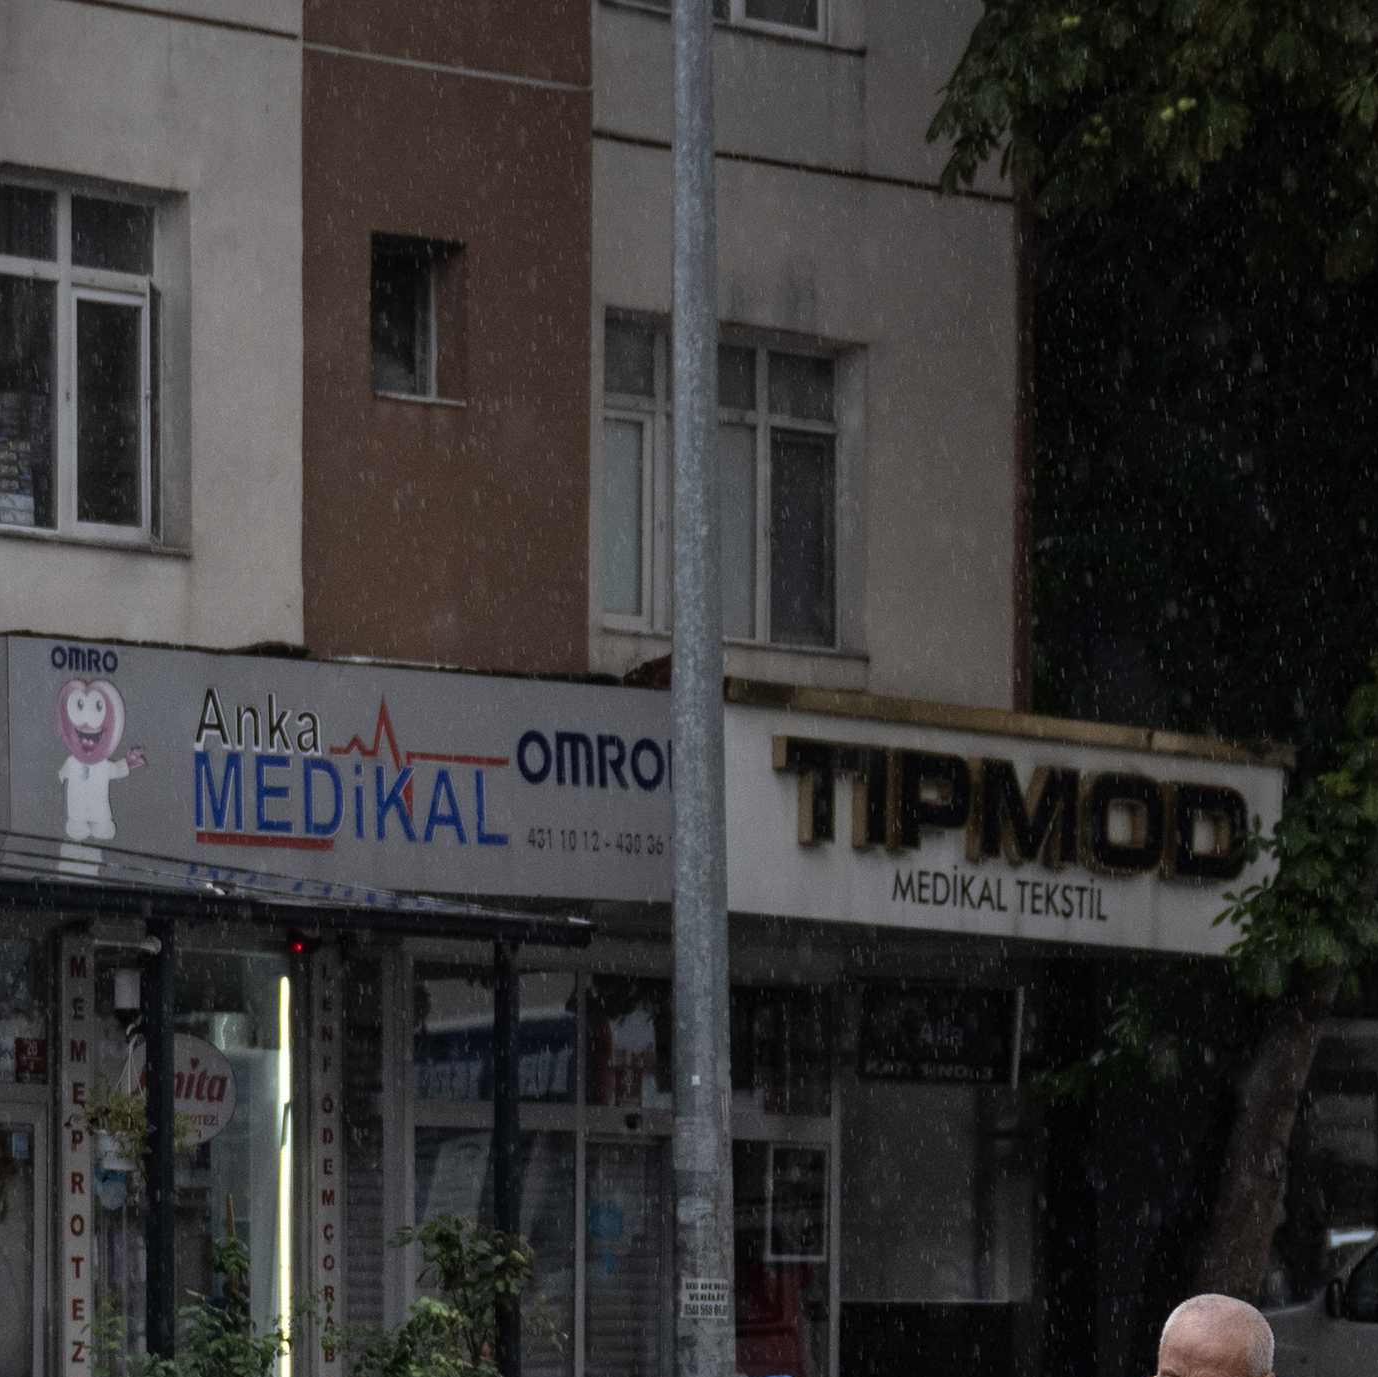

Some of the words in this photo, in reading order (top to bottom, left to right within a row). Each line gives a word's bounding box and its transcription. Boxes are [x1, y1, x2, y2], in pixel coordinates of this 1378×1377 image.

[195, 687, 321, 755] Anka
[517, 730, 673, 793] OMRO
[528, 828, 552, 849] 431
[561, 829, 577, 851] 10
[584, 831, 600, 852] 12
[773, 735, 1252, 882] TIPMOD
[892, 865, 1007, 913] MEDİKAL
[1016, 878, 1108, 922] TEKSTİL
[70, 956, 87, 1104] MEME
[140, 1056, 228, 1103] nita
